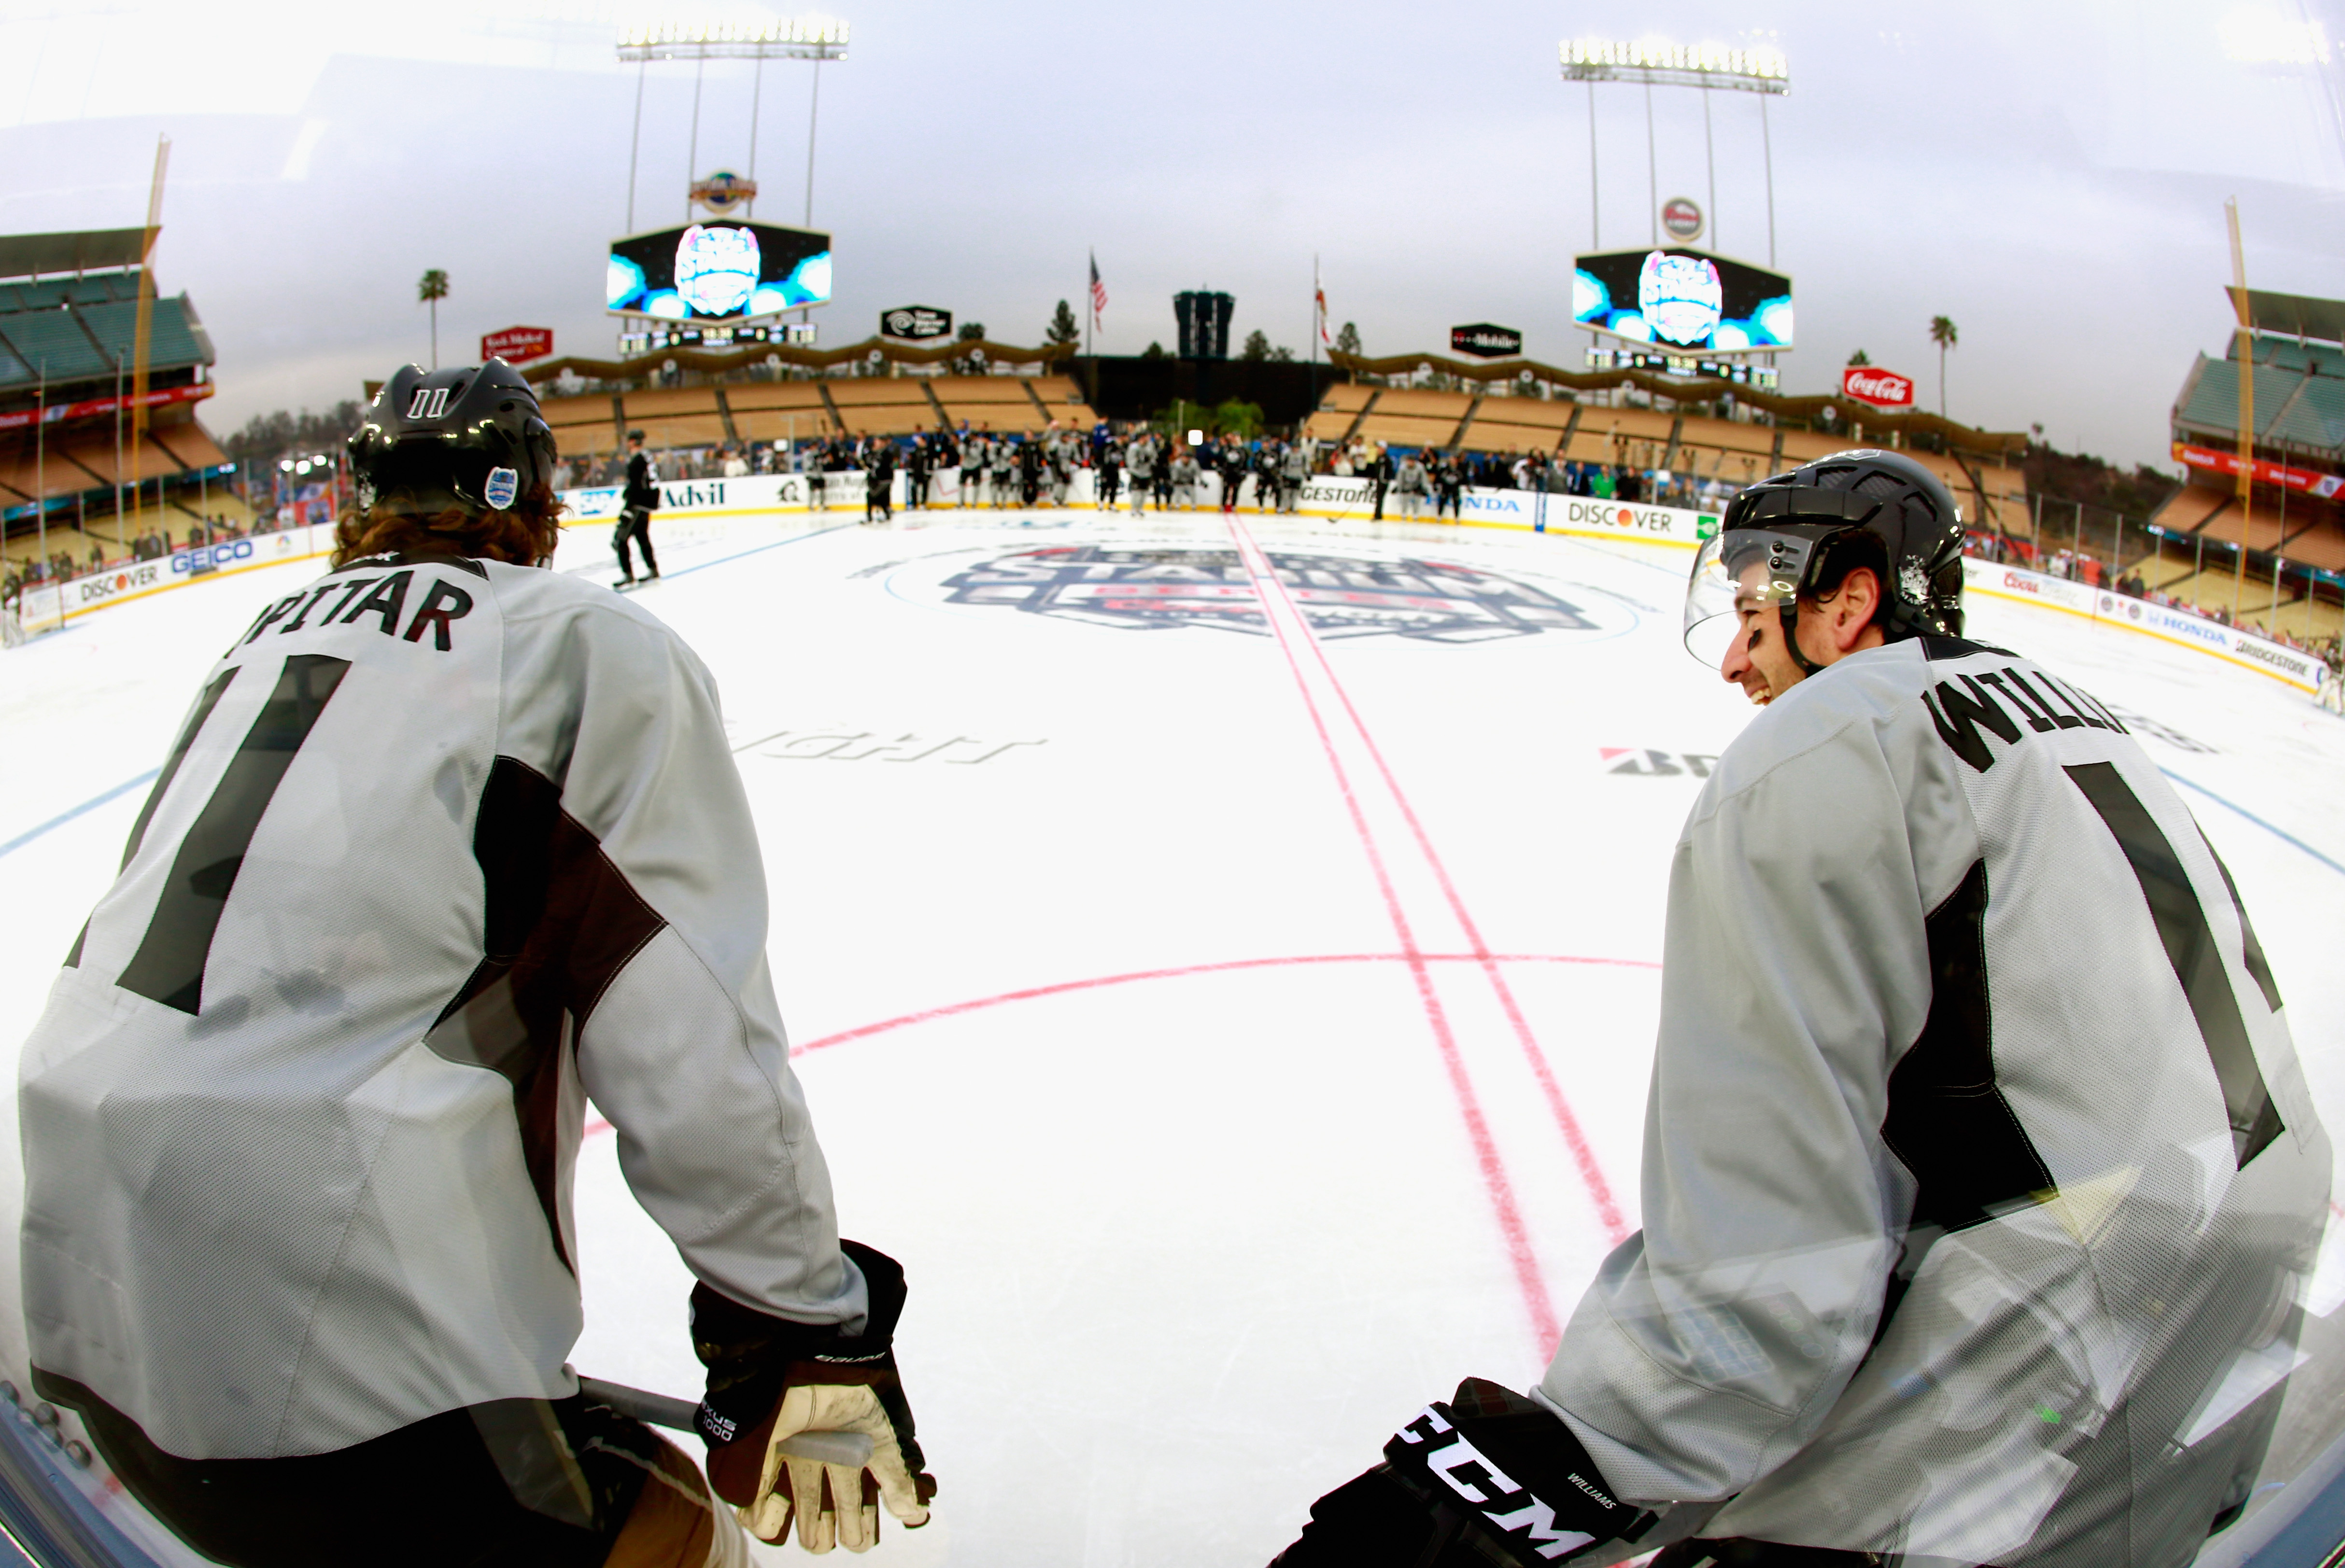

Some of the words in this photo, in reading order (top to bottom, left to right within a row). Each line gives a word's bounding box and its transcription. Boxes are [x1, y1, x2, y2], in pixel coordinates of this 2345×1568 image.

[407, 388, 449, 419] 11
[660, 482, 725, 507] Advil
[1569, 503, 1672, 532] DISCOVER
[171, 541, 254, 574] GEICO
[81, 565, 159, 602] DISCOVER
[2163, 617, 2228, 645] HONDA
[703, 1415, 733, 1442] 1000
[1568, 1472, 1617, 1509] WILLIAMS
